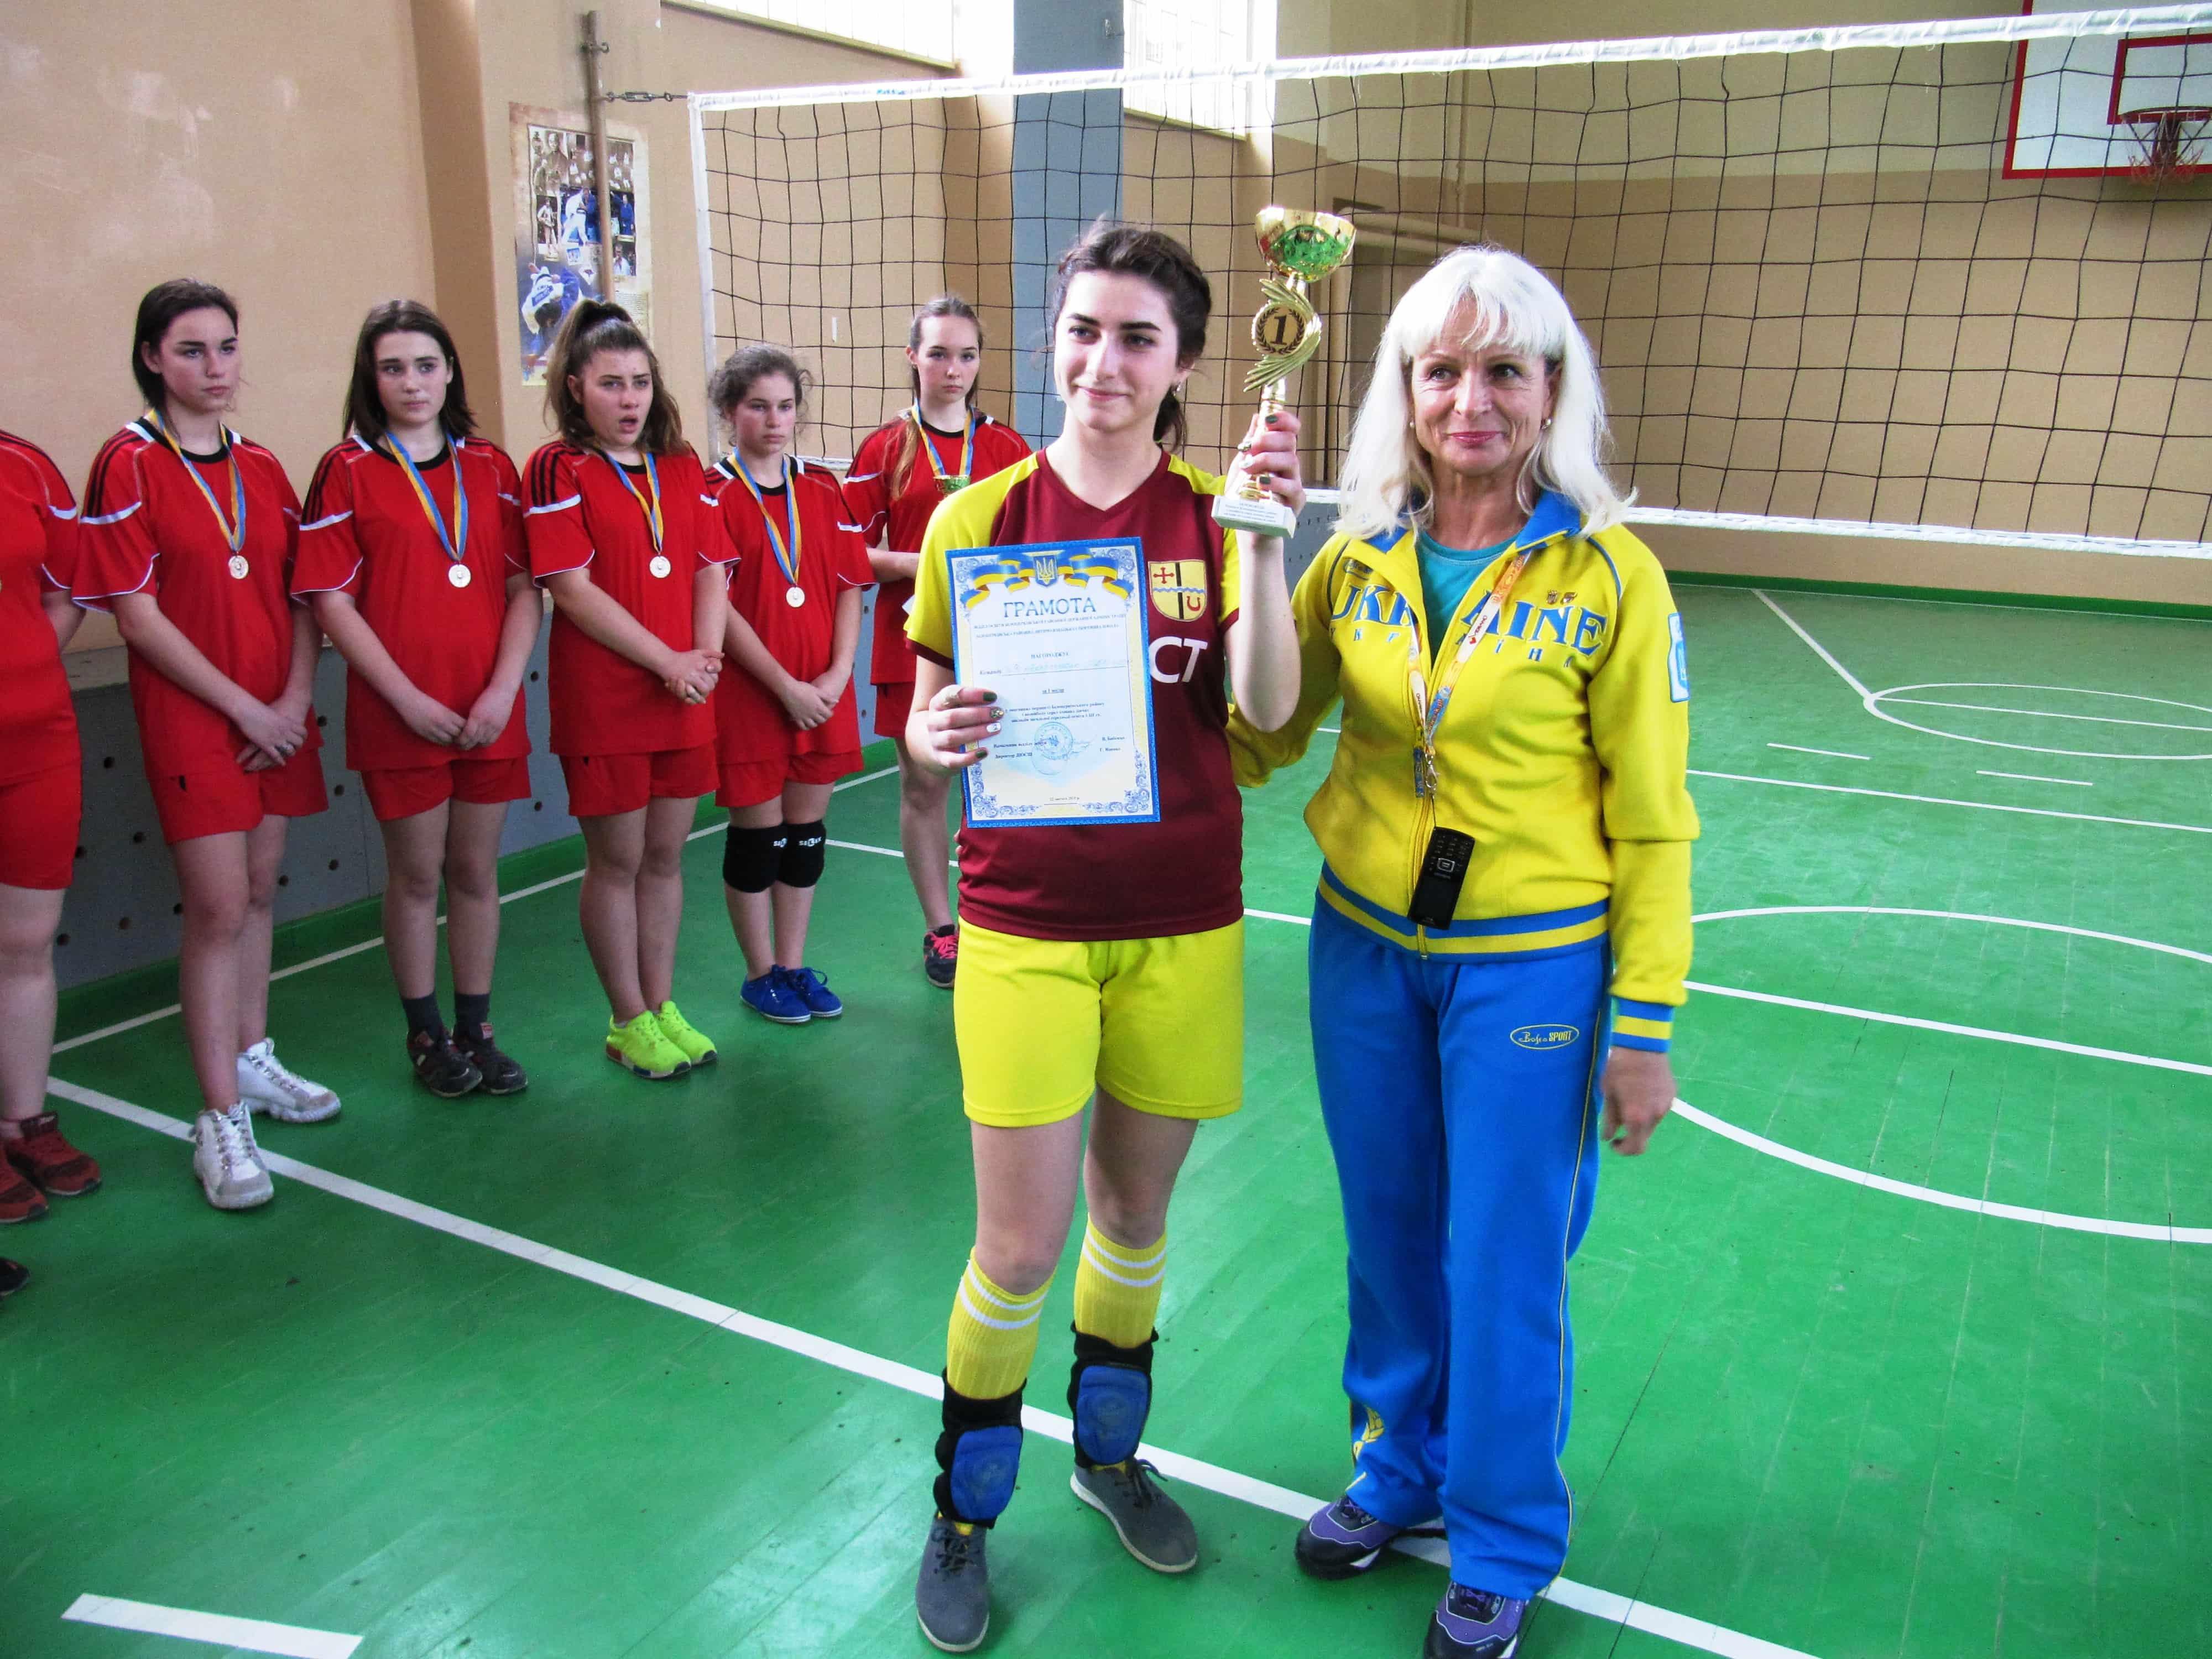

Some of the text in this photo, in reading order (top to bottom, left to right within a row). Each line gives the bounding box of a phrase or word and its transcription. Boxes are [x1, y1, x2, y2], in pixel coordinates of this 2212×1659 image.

[1269, 315, 1287, 346] 1
[1003, 597, 1097, 618] ГРАМОТА
[1548, 1030, 1573, 1042] SPORT
